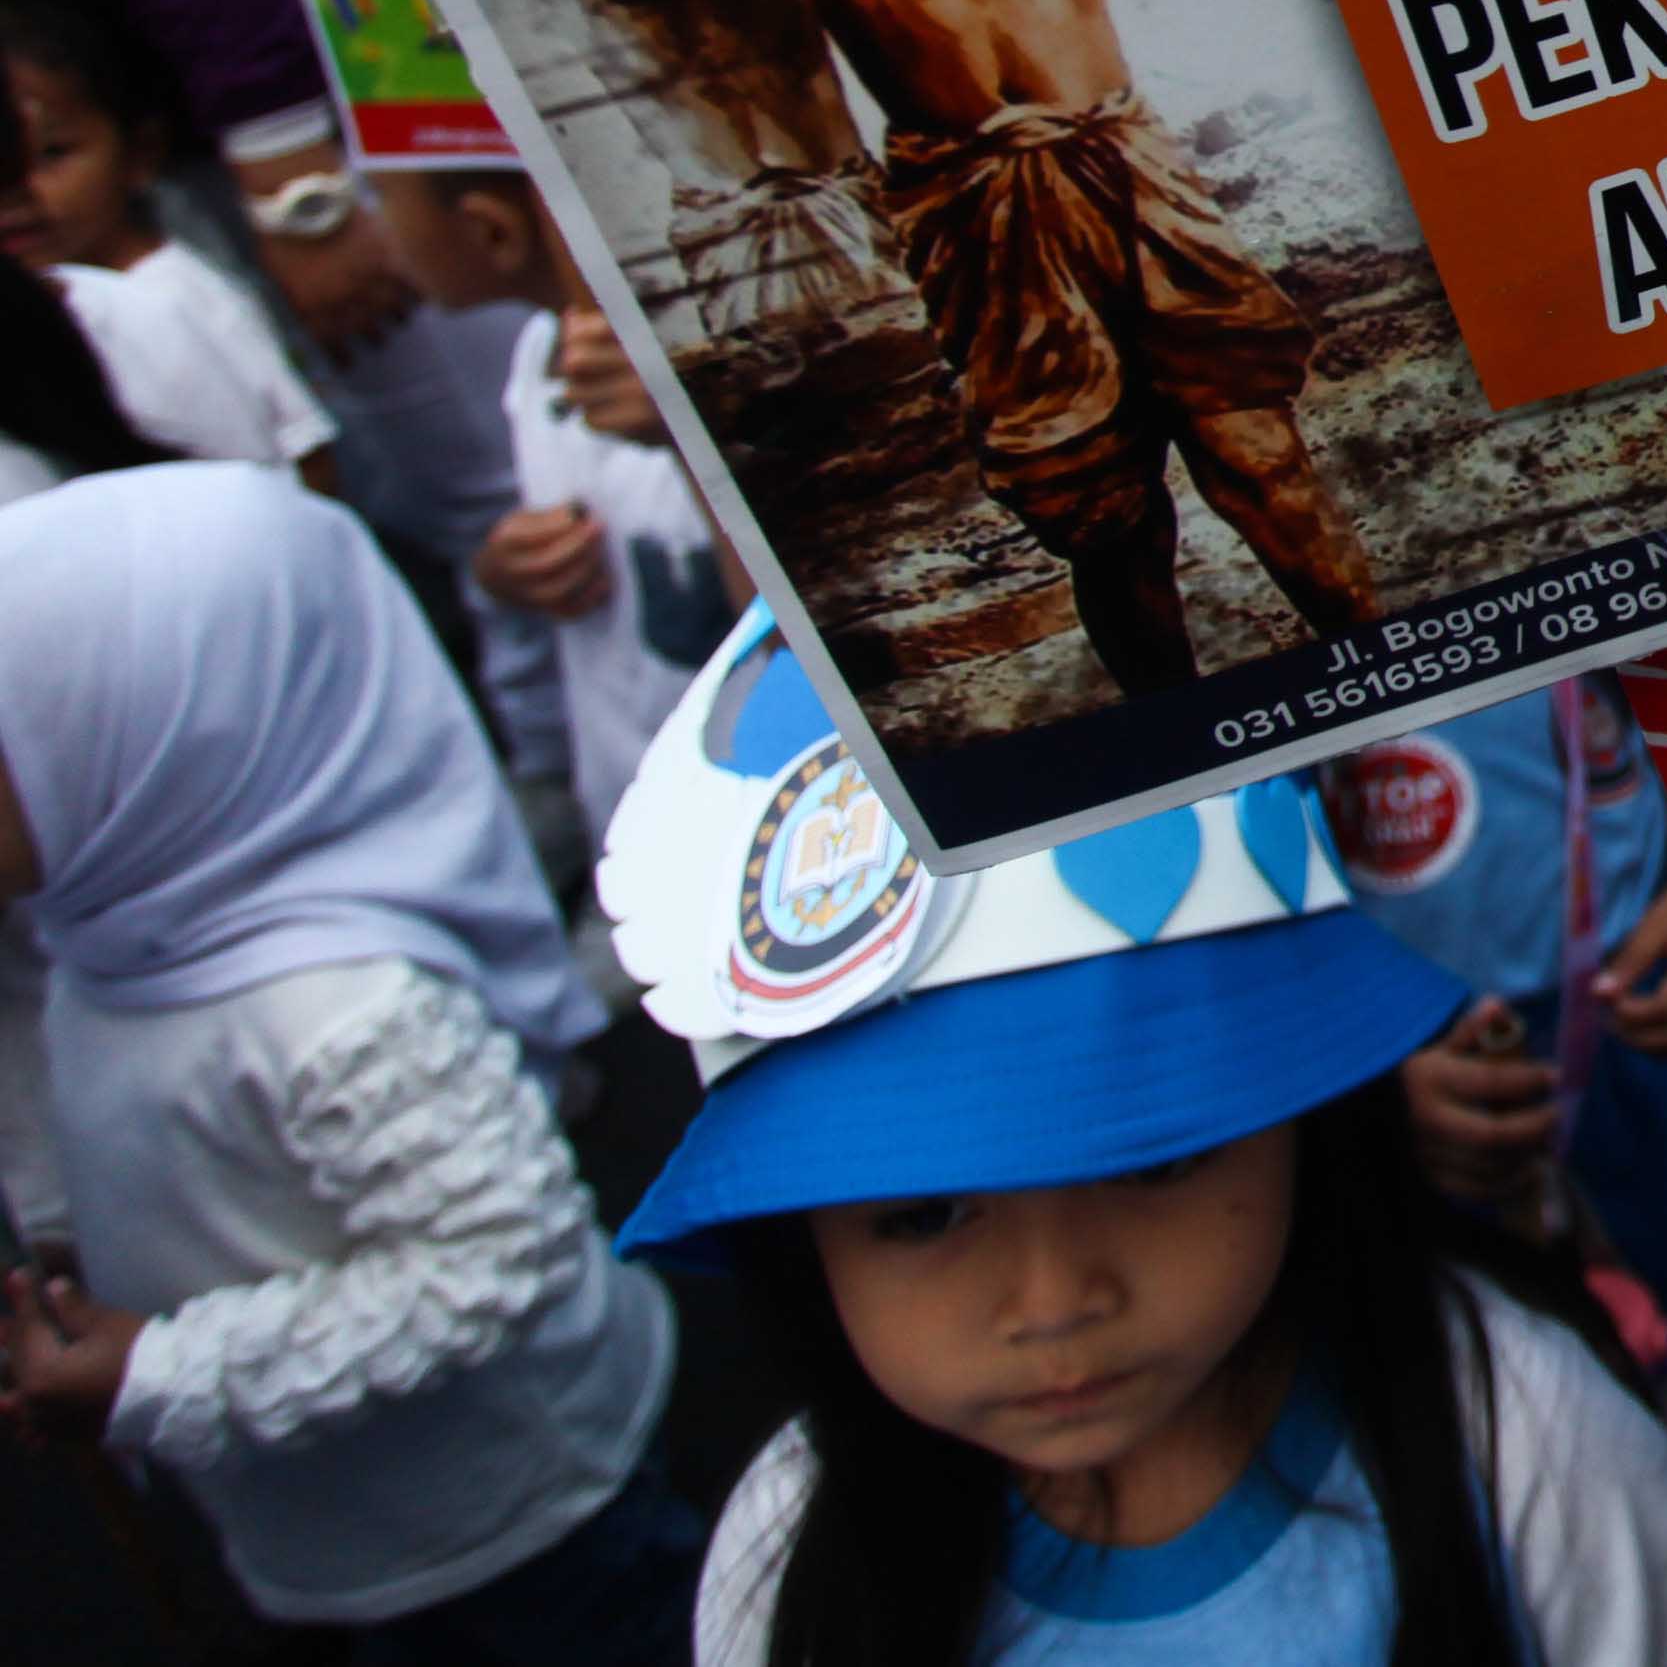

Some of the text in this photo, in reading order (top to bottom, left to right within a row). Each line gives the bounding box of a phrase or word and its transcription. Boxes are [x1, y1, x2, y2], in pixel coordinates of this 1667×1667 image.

[1213, 703, 1297, 751] 031
[1304, 634, 1501, 721] 5616593
[1538, 603, 1601, 646] 08
[1323, 637, 1375, 676] Jl.
[1386, 553, 1637, 655] Bogowonto
